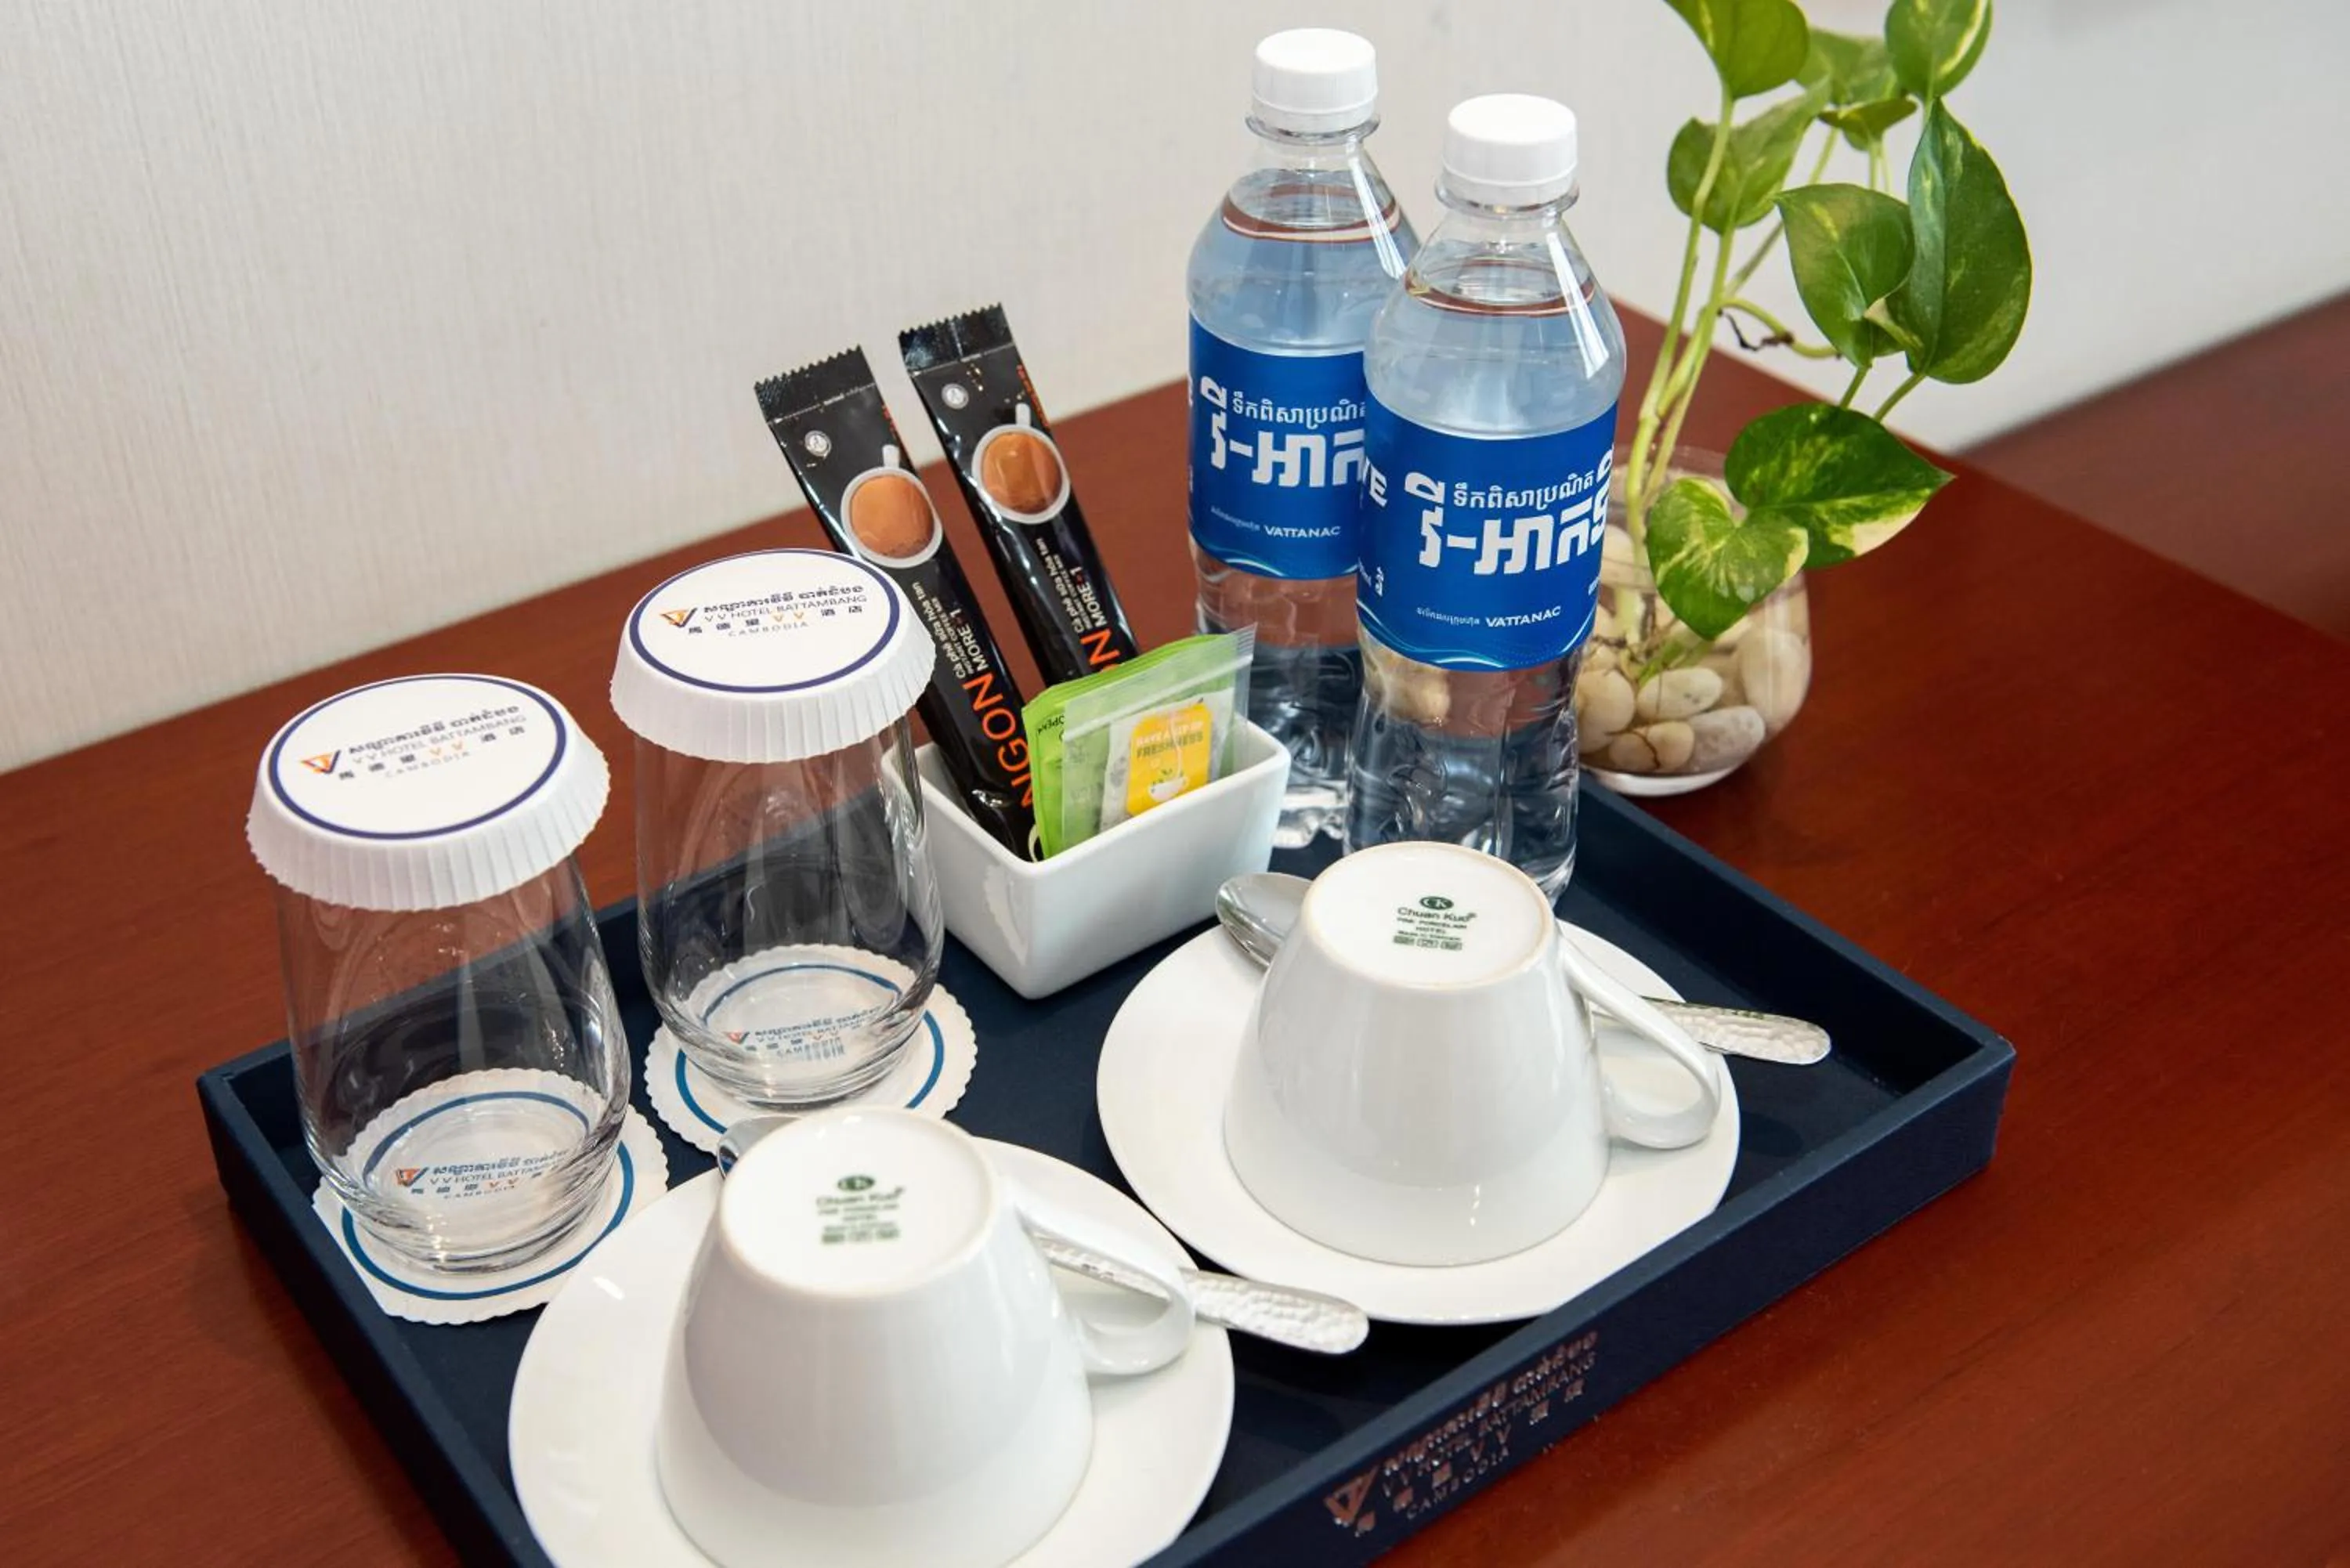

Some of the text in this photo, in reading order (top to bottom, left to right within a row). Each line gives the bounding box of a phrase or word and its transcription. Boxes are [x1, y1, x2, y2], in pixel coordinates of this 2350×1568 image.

[1264, 516, 1341, 538] VATTANAC
[912, 582, 926, 600] tan
[731, 605, 772, 619] HOTEL
[776, 594, 868, 612] BATTAMBANG
[1485, 605, 1561, 627] VATTANAC
[728, 620, 809, 637] CAMBODIA
[942, 642, 960, 662] phê
[953, 662, 966, 679] Cà
[381, 740, 425, 757] HOTEL
[429, 714, 526, 744] BATTAMBANG
[1397, 907, 1440, 919] Chuan
[454, 1171, 493, 1183] HOTEL
[1407, 1447, 1510, 1519] CAMBODIA
